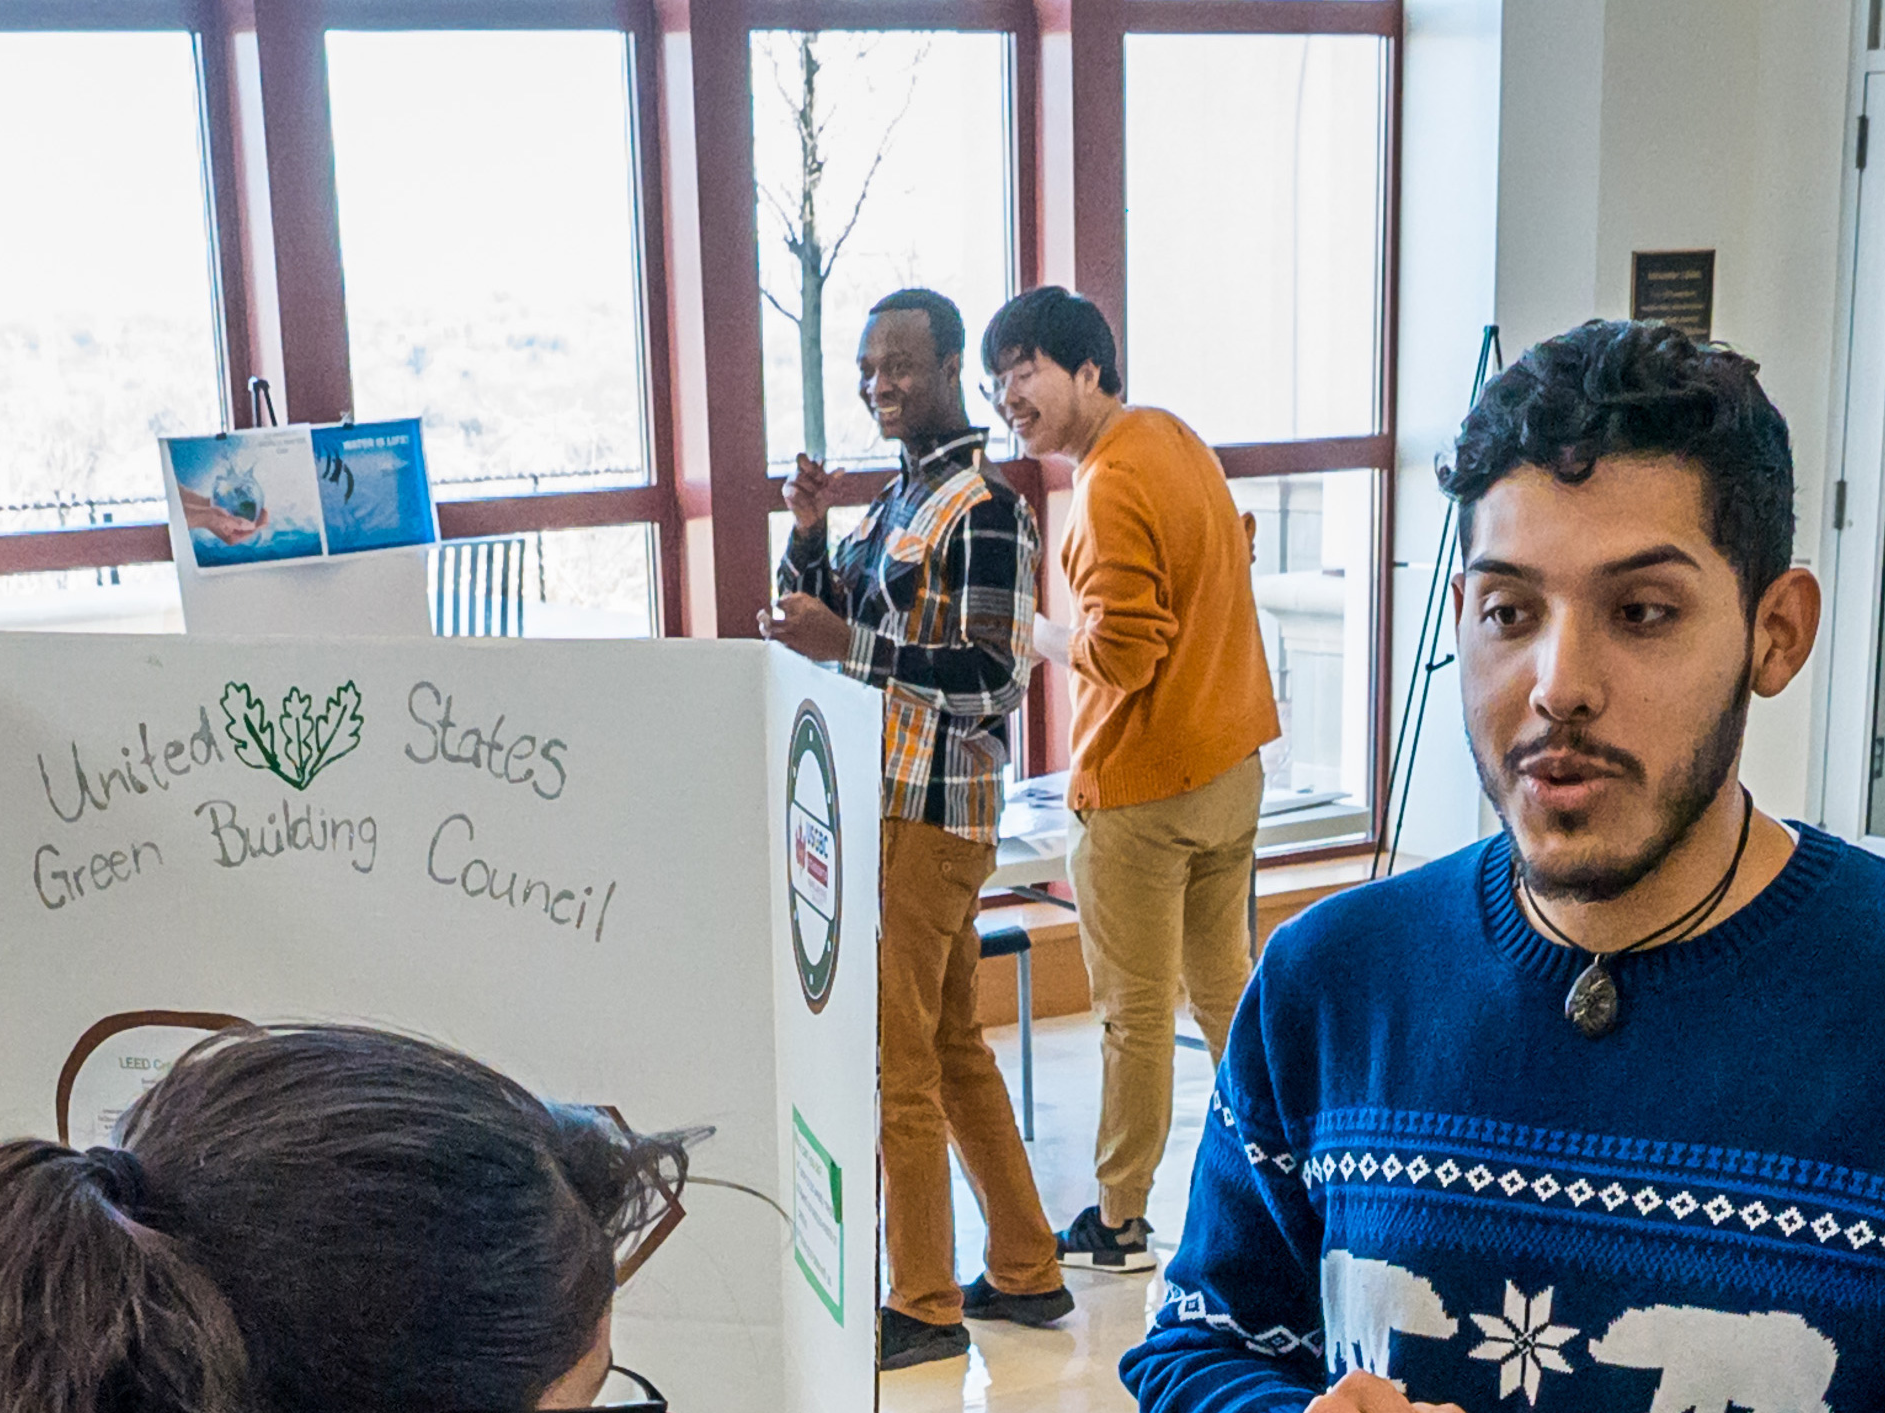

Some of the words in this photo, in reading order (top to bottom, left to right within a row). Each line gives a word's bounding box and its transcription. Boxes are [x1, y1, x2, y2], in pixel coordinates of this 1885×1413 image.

[38, 706, 224, 822] United
[405, 681, 568, 800] States
[34, 841, 163, 909] Green
[195, 798, 378, 873] Building
[427, 813, 616, 942] Council
